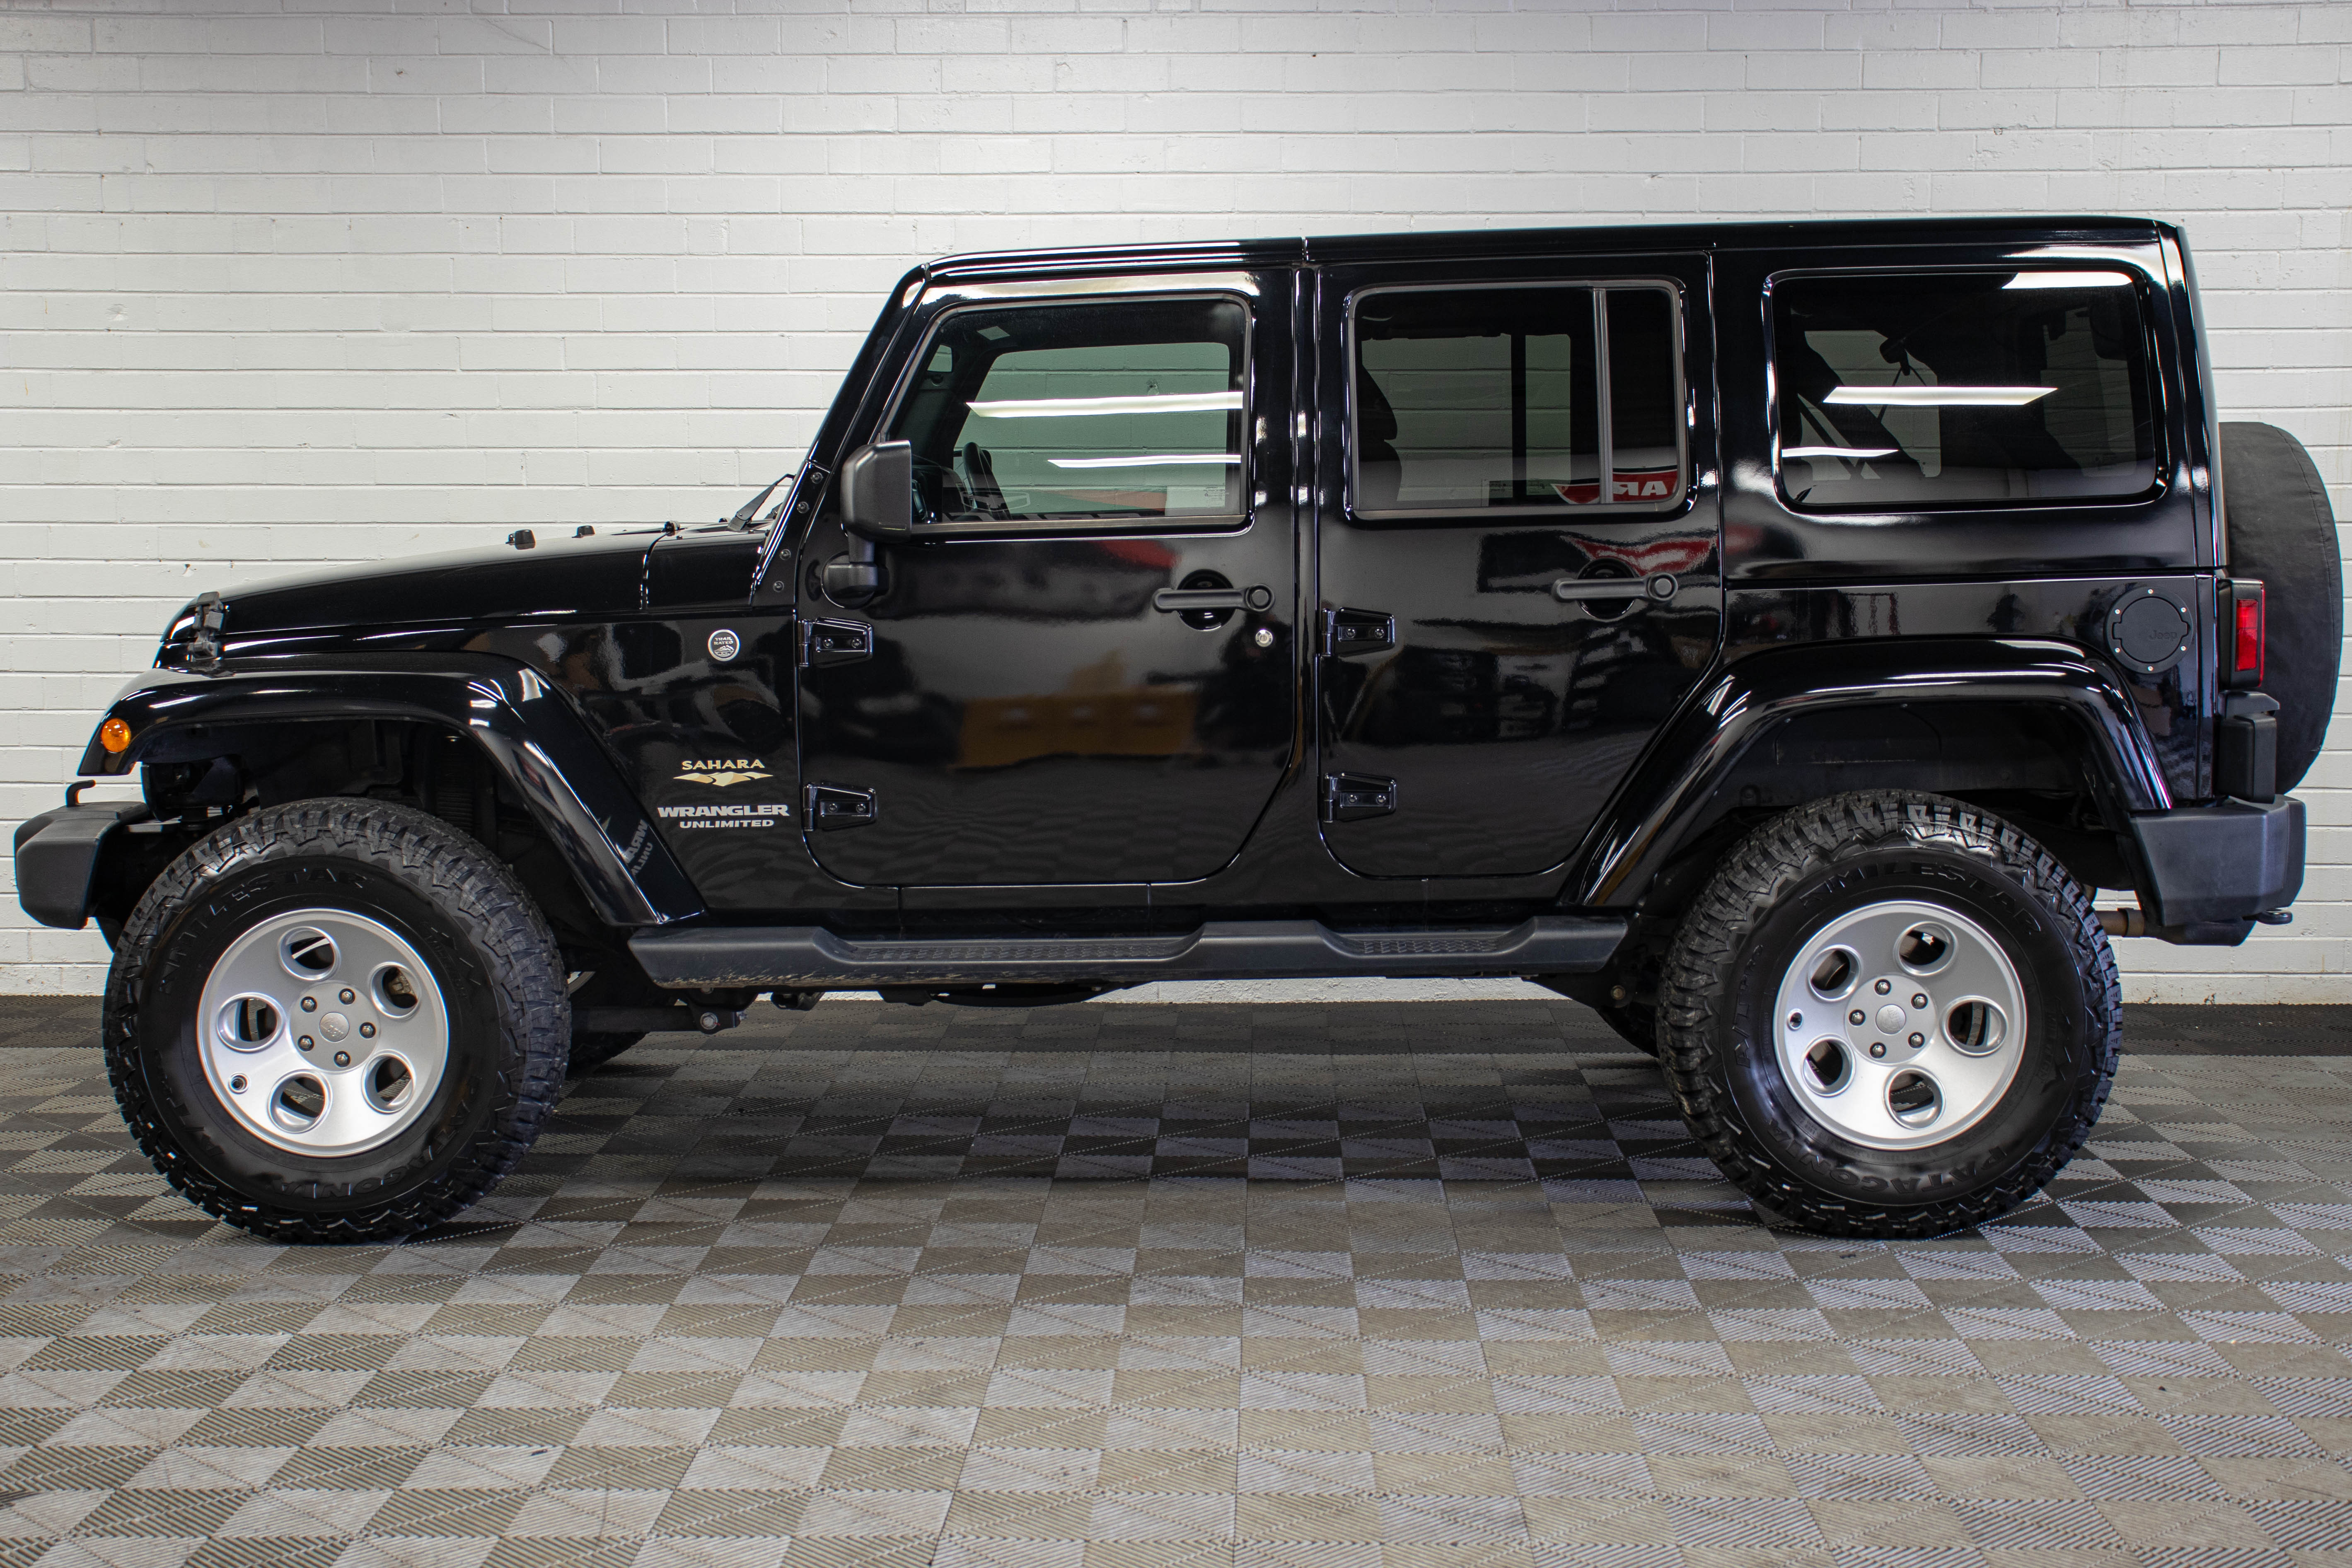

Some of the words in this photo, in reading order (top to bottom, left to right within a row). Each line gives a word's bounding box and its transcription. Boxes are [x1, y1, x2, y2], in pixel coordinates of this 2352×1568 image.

[2149, 630, 2178, 641] Jeep
[682, 759, 765, 770] SAHARA
[657, 805, 790, 817] WRANGLER
[679, 819, 774, 829] UNLIMITED
[1823, 860, 2042, 935] MILESTAR
[1767, 1119, 2007, 1194] PATAGONIA
